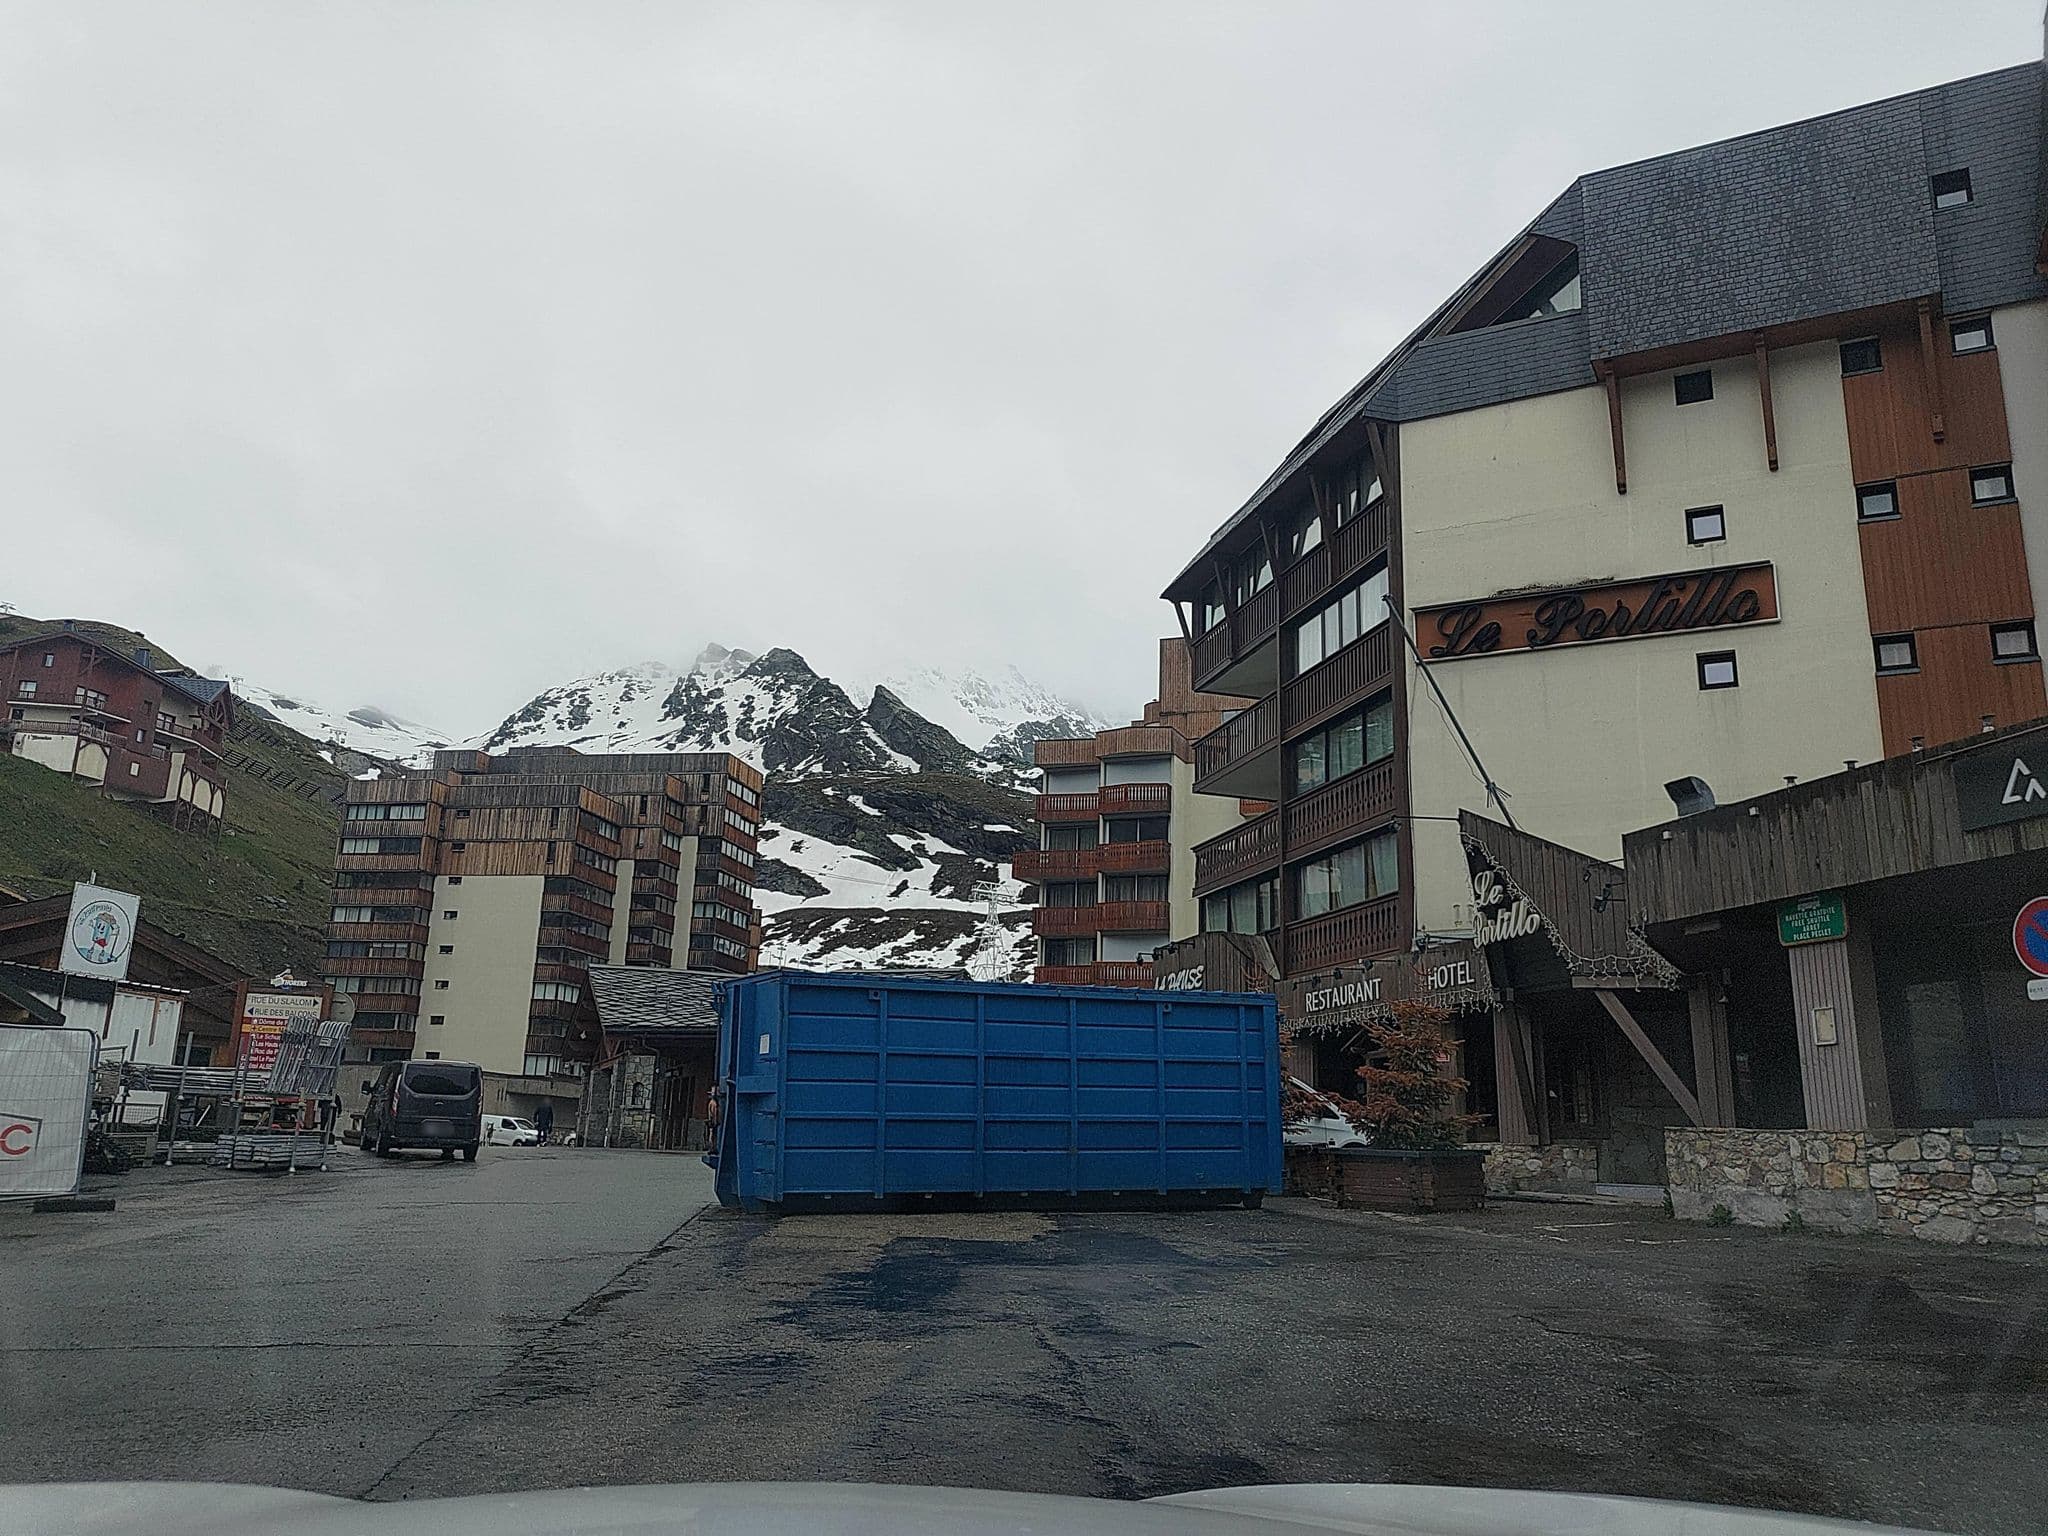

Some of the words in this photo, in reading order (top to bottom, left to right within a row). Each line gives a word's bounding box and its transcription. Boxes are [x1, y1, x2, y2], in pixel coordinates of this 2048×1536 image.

[1429, 604, 1501, 658] Le
[1526, 569, 1761, 649] Portillo
[1474, 870, 1504, 908] Le
[1473, 901, 1540, 948] Portillo
[251, 996, 267, 1004] RUE
[268, 997, 280, 1005] DU
[280, 998, 312, 1006] SLALOM
[1305, 978, 1382, 1012] RESTAURANT
[1427, 960, 1475, 990] HOTEL
[254, 1008, 268, 1016] RUE
[269, 1009, 284, 1017] DES
